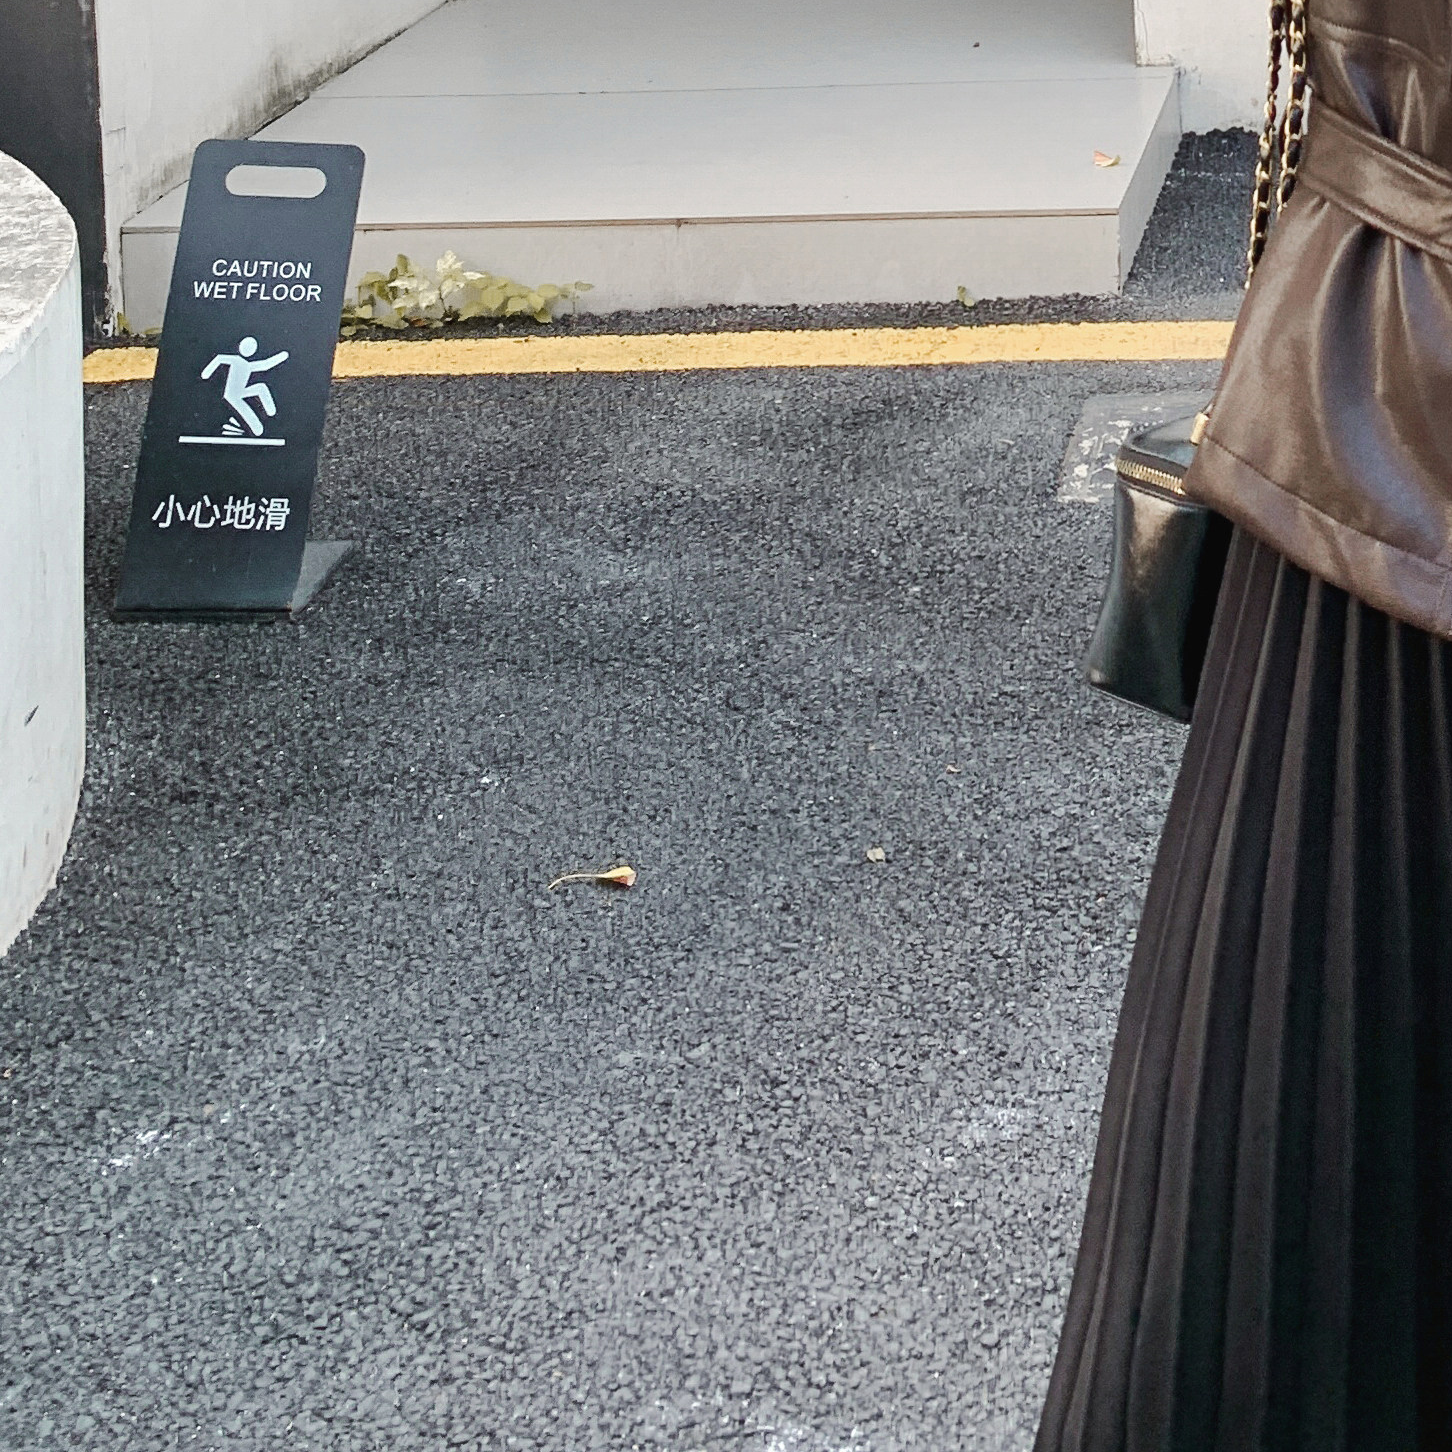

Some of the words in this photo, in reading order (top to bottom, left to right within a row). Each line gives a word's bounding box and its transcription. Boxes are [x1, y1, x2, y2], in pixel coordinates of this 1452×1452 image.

[212, 259, 312, 279] CAUTION
[193, 280, 243, 300] WET
[246, 282, 322, 302] FLOOR
[151, 494, 291, 531] 小心地滑
